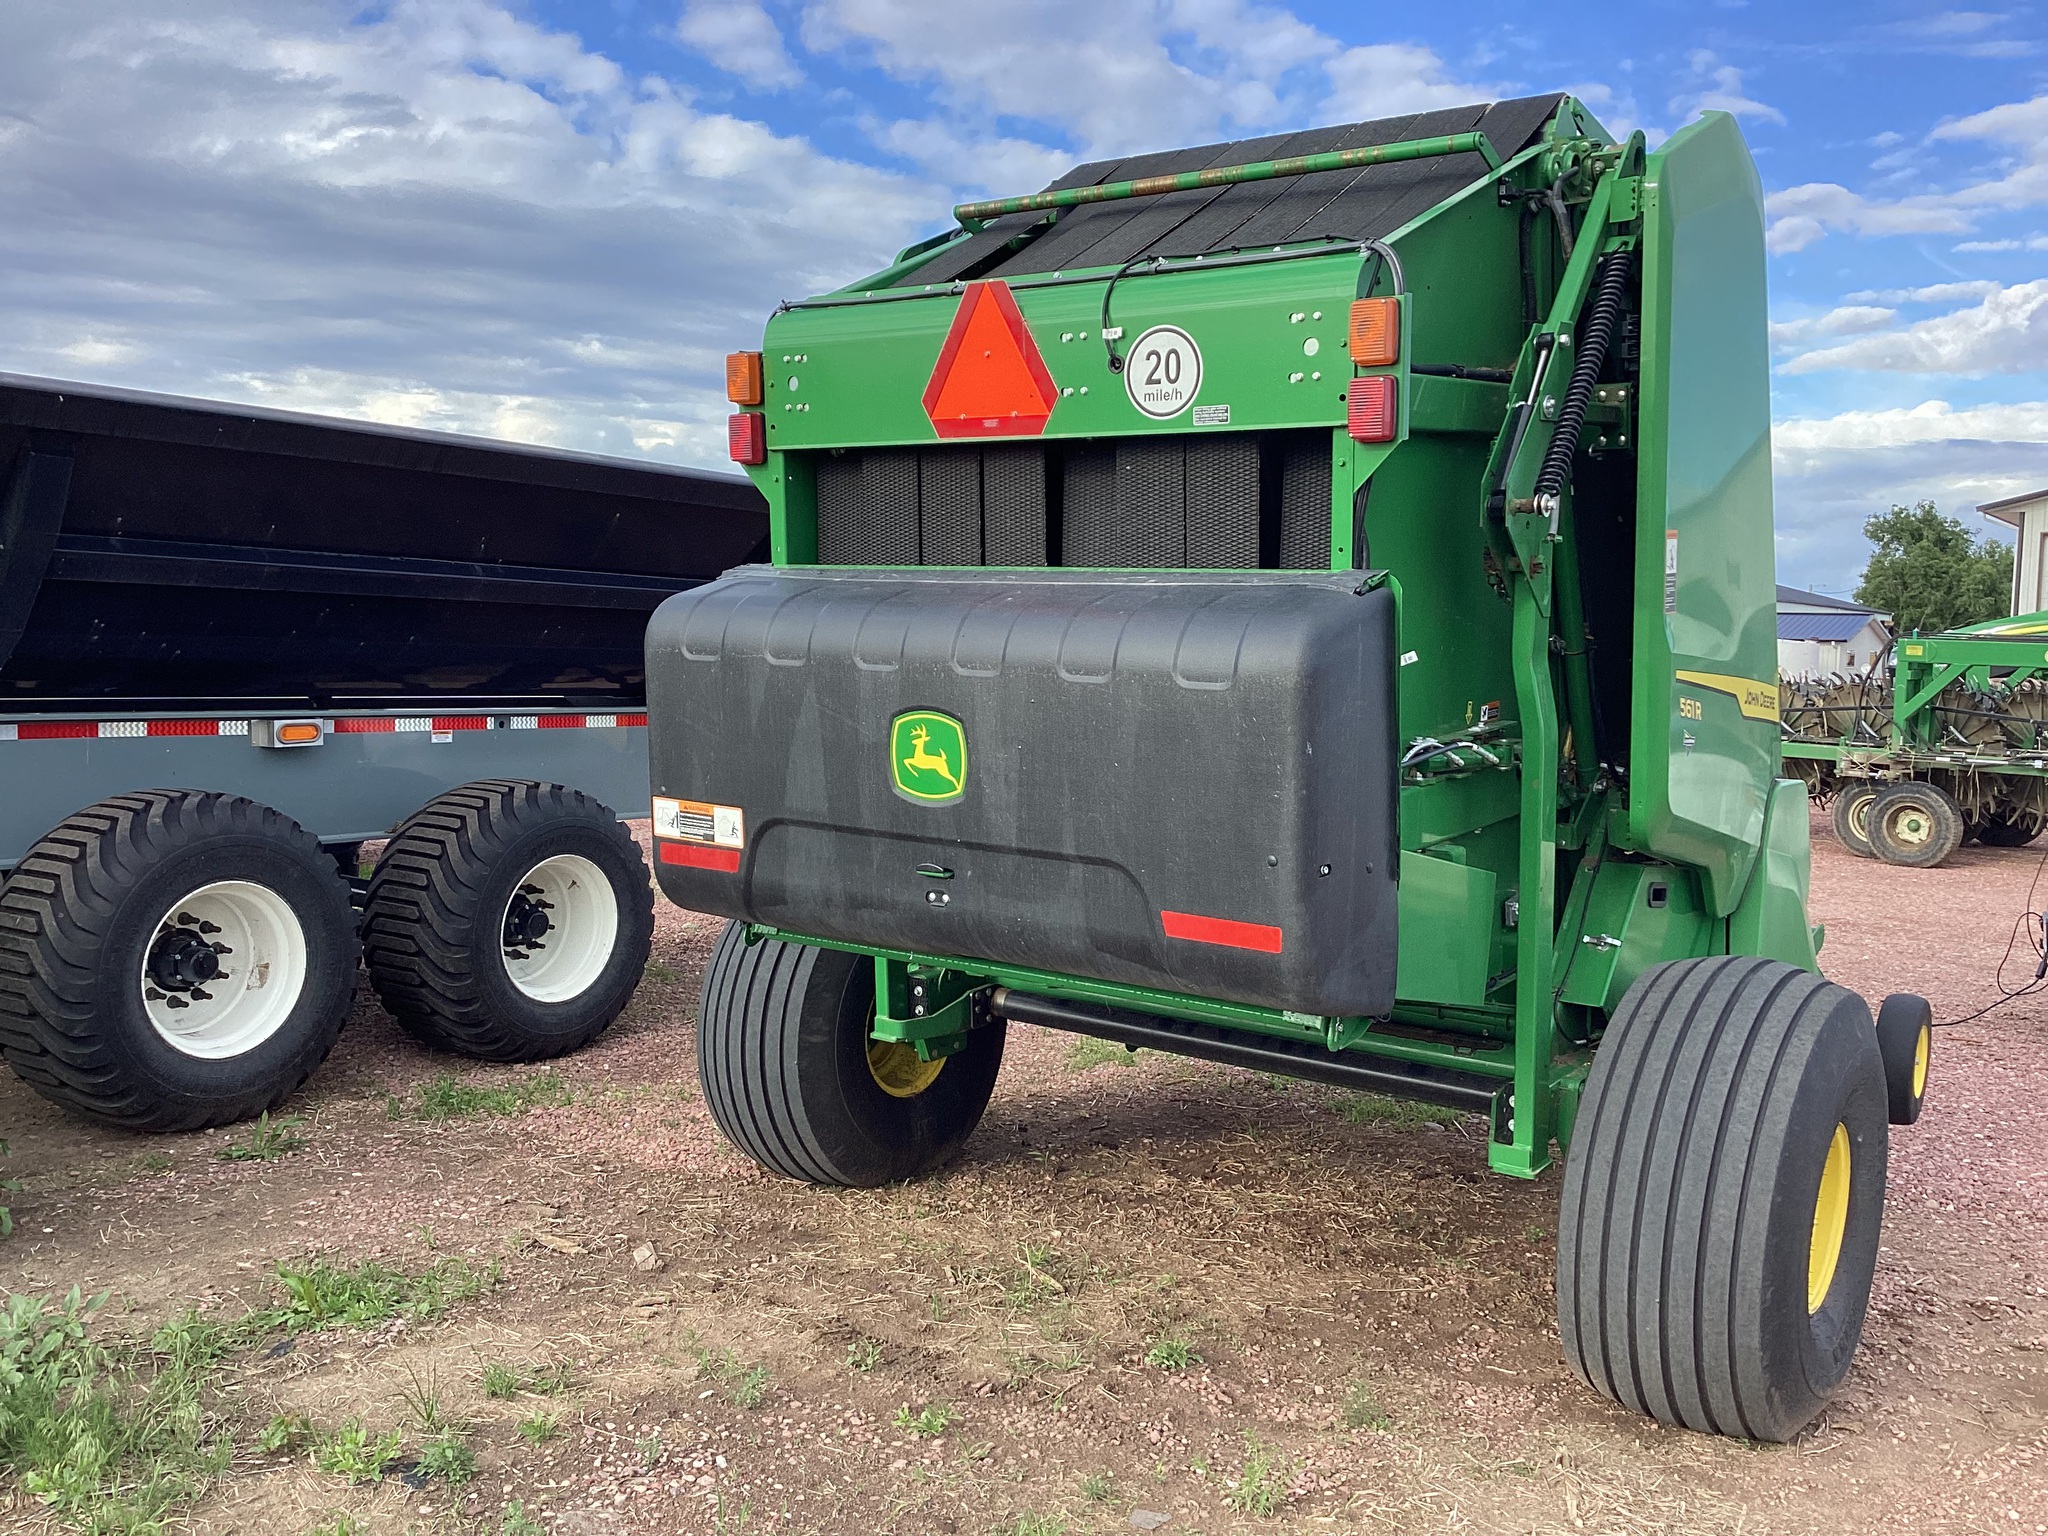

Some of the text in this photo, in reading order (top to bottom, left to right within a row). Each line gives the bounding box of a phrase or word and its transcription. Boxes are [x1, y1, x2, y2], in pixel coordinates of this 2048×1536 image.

[1144, 348, 1181, 386] 20
[1143, 388, 1183, 402] mile/h
[1744, 687, 1775, 710] JOHN DEERE
